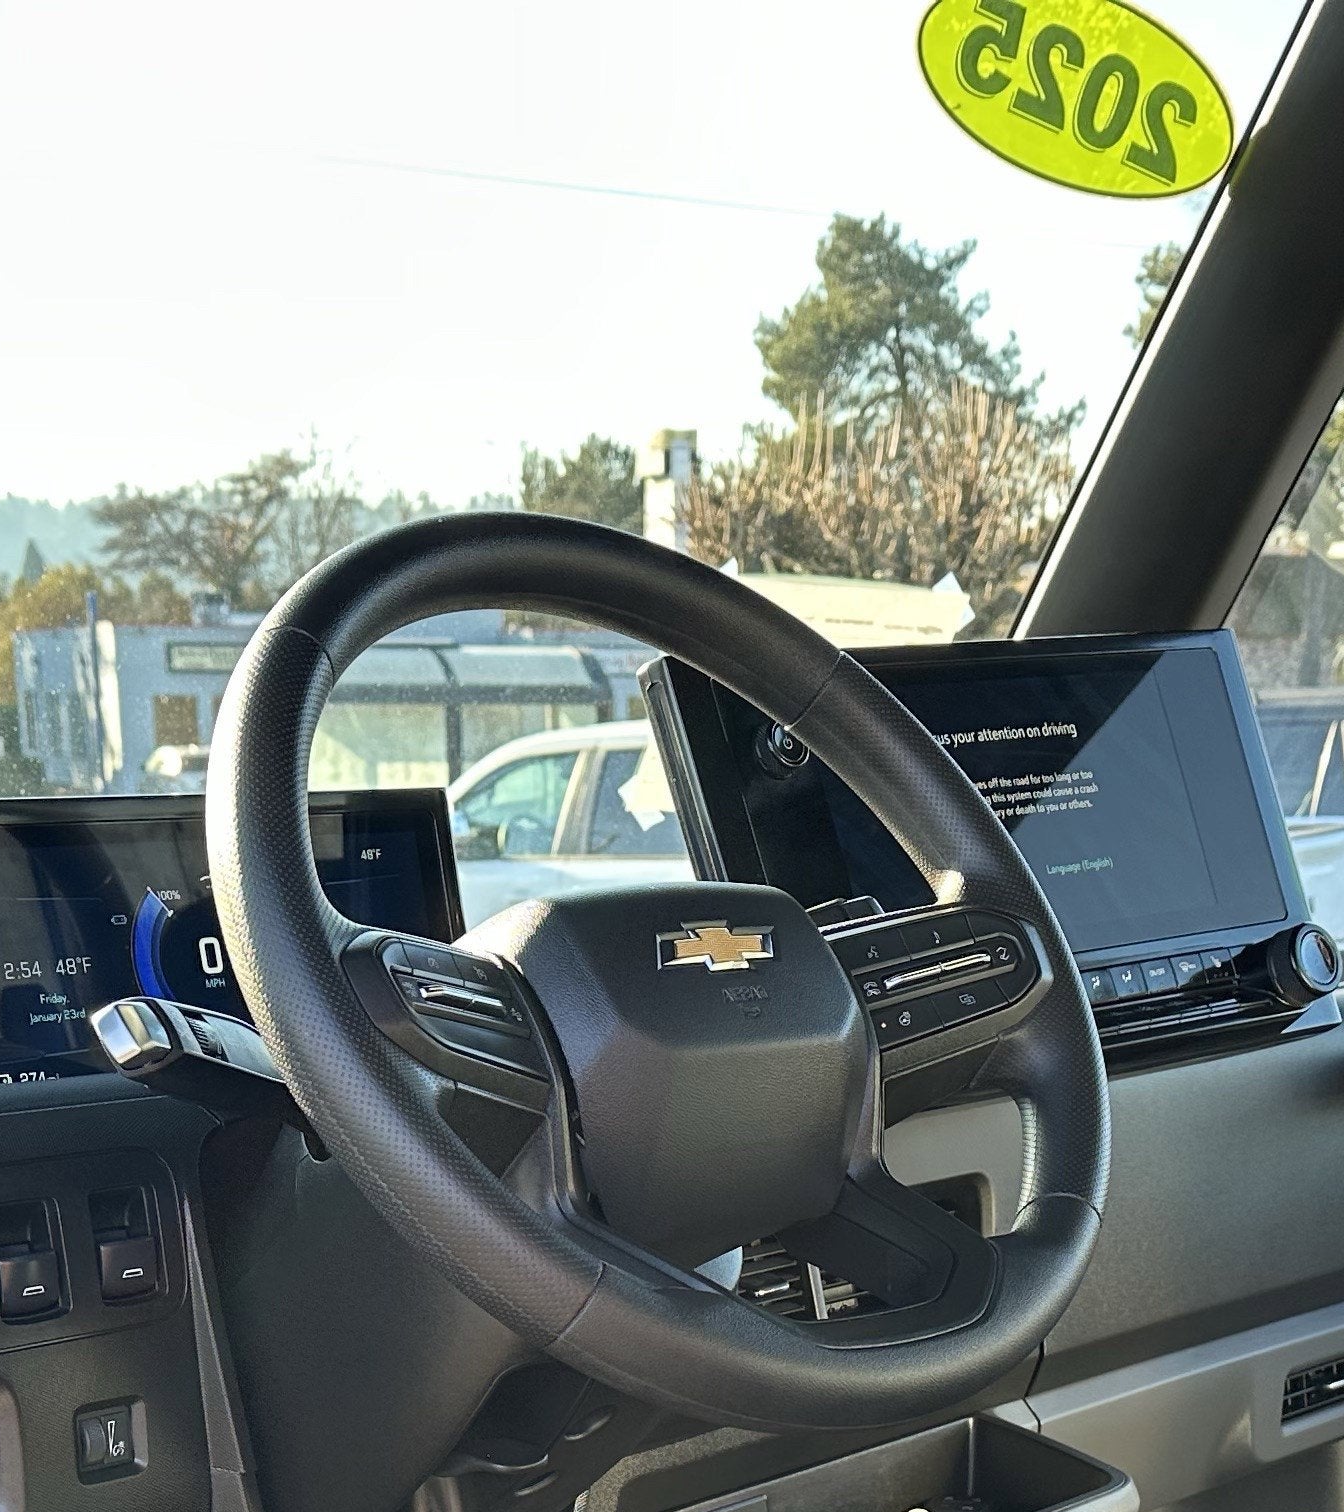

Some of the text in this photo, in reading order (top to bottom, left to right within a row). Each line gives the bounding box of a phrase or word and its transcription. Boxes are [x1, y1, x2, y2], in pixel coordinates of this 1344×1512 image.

[932, 721, 1078, 748] us your attention on driving
[999, 776, 1013, 787] the
[1013, 774, 1030, 786] road
[991, 792, 1007, 803] this
[1006, 791, 1033, 804] system
[1032, 787, 1053, 799] could
[1052, 787, 1074, 797] cause
[1079, 782, 1099, 793] crash
[1015, 803, 1037, 816] death
[1045, 856, 1114, 876] Language (English)
[198, 936, 224, 975] 0
[3, 956, 93, 980] 2:54 48°F
[205, 978, 226, 989] MPH
[29, 1007, 87, 1026] January 23rd
